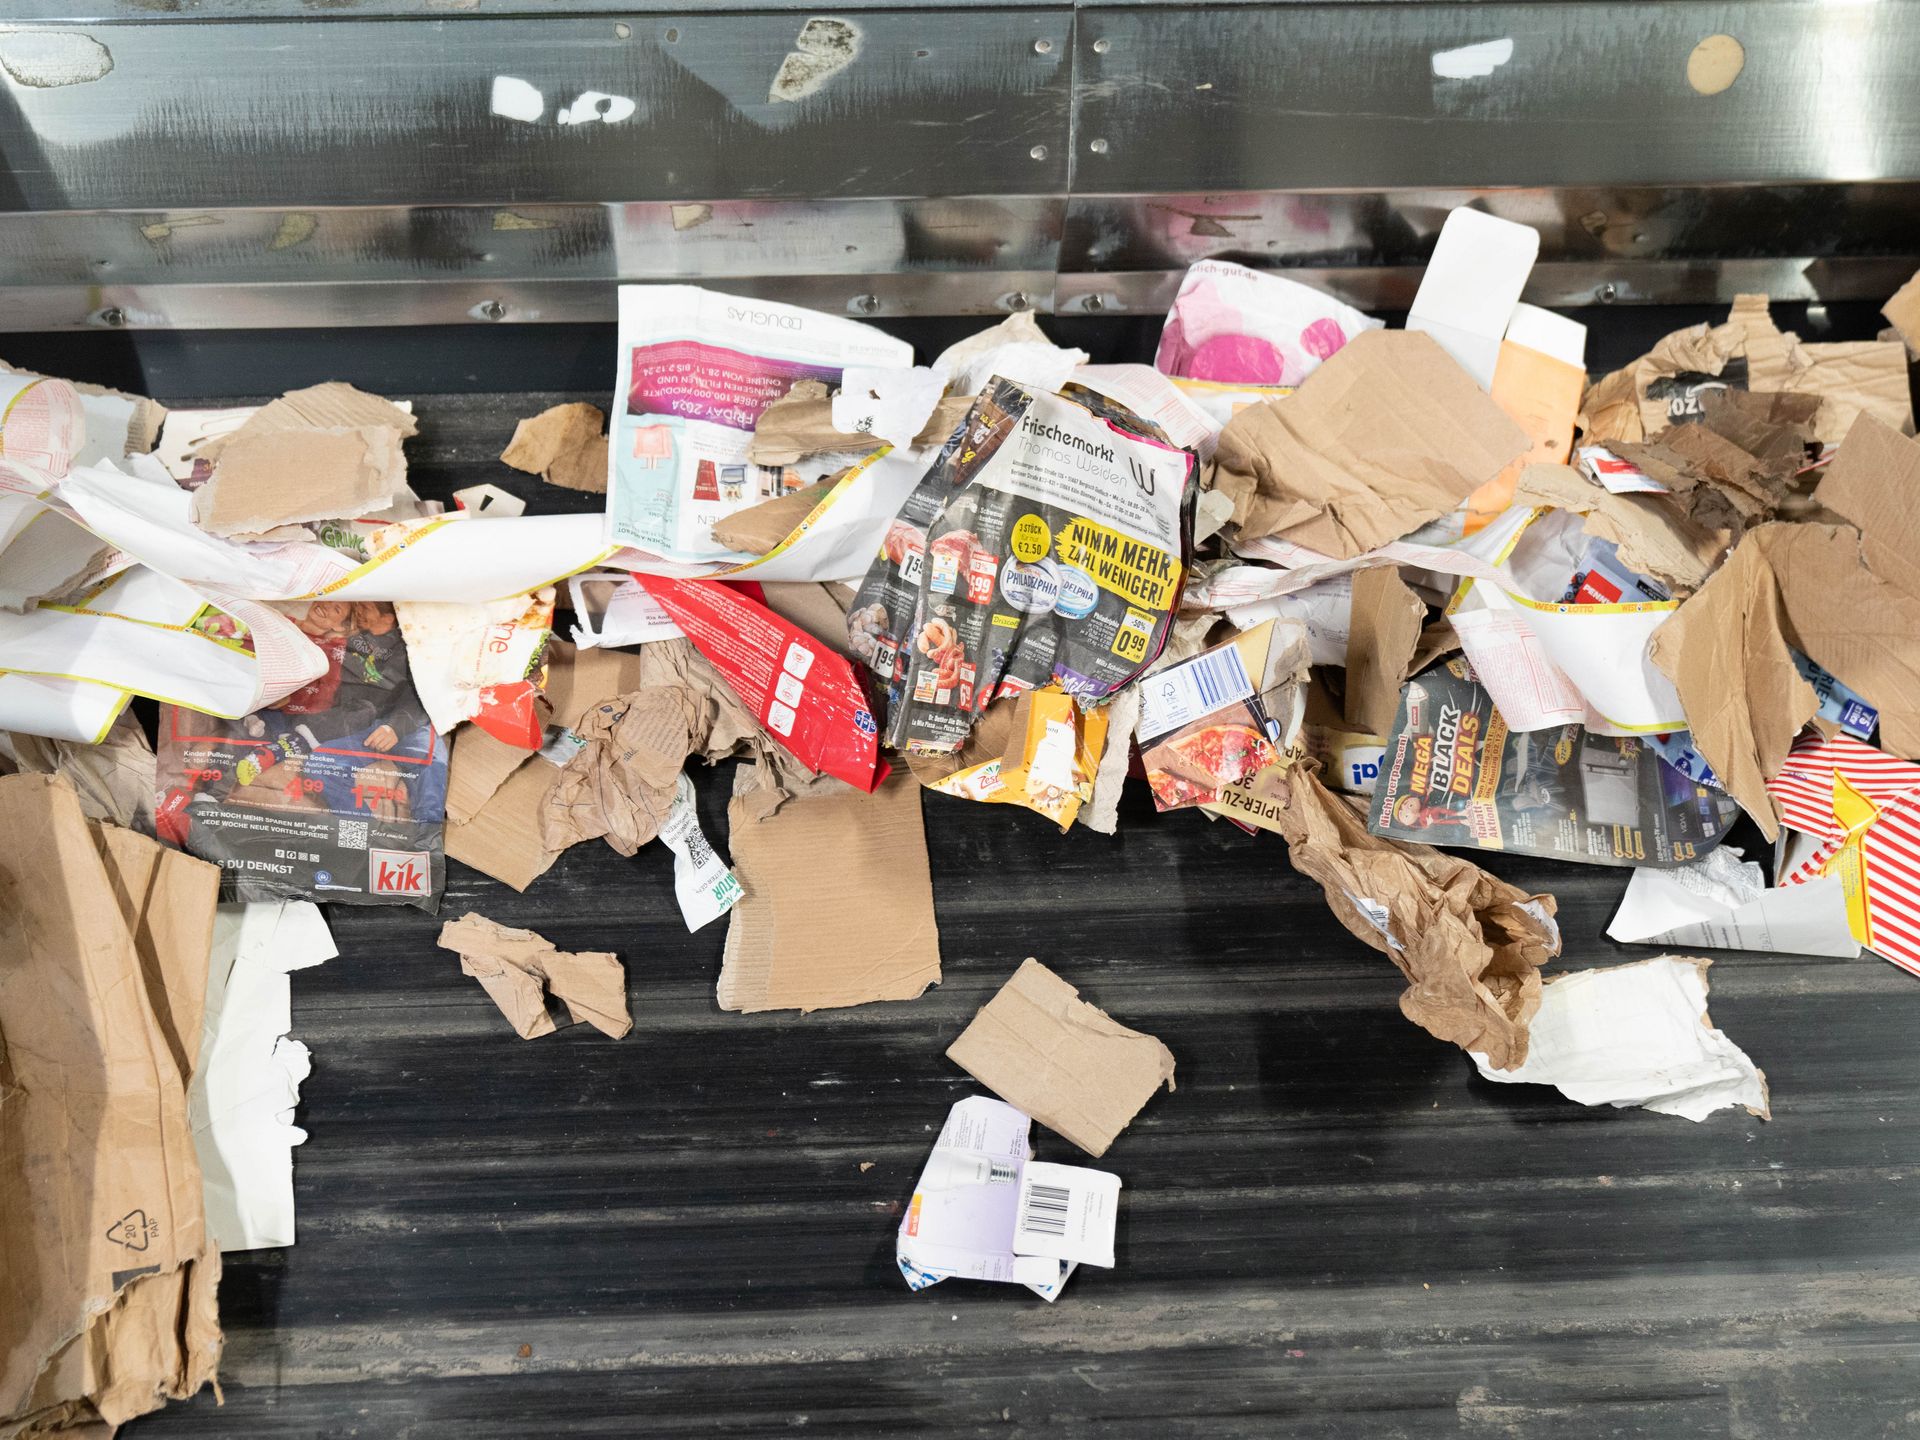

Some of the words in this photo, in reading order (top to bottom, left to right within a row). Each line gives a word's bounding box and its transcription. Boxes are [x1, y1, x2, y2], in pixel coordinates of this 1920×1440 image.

[728, 306, 802, 331] DOUGLAS
[677, 363, 691, 373] BIS
[722, 371, 744, 383] VOM
[657, 375, 679, 385] UND
[746, 377, 781, 387] ONLINE
[643, 387, 692, 398] PRODUKTE
[694, 389, 731, 402] 100.000
[734, 395, 758, 408] ÜBER
[672, 400, 704, 416] 2024
[706, 406, 754, 425] FRIDAY
[1022, 416, 1115, 463] Frischemarkt
[1018, 436, 1071, 465] Thomas
[1076, 455, 1128, 488] Weiden
[784, 527, 803, 548] WEST
[807, 503, 828, 526] LOTTO
[1119, 535, 1174, 587] MEHR,
[1006, 568, 1059, 598] PHILADELPHIA
[1067, 544, 1099, 576] ZAHL
[1100, 557, 1164, 607] WENIGER!
[322, 578, 350, 594] LOTTO
[1534, 602, 1560, 613] WEST
[1567, 603, 1595, 614] LOTTO
[1062, 673, 1096, 694] Milka
[183, 750, 206, 759] Kinder
[207, 751, 235, 760] Pullover
[1432, 707, 1459, 791] BLACK
[1453, 714, 1480, 796] DEALS
[310, 755, 335, 763] Socken
[1411, 736, 1432, 794] MEGA
[351, 765, 374, 775] Herren
[1479, 753, 1490, 789] Freitag
[1487, 754, 1499, 788] Montag
[1379, 798, 1395, 828] Nicht
[1388, 734, 1408, 795] verpassen!
[196, 810, 219, 819] JETZT
[220, 812, 242, 821] NOCH
[243, 814, 264, 823] MEHR
[265, 816, 293, 825] SPAREN
[294, 821, 307, 829] MIT
[201, 818, 220, 827] JEDE
[221, 819, 249, 830] WOCHE
[249, 823, 270, 832] NEUE
[270, 824, 329, 840] VORTEILSPREISE
[227, 859, 245, 870] DU
[247, 860, 295, 875] DENKST
[377, 858, 424, 892] kik
[125, 1224, 137, 1239] 20
[149, 1218, 160, 1238] PAP
